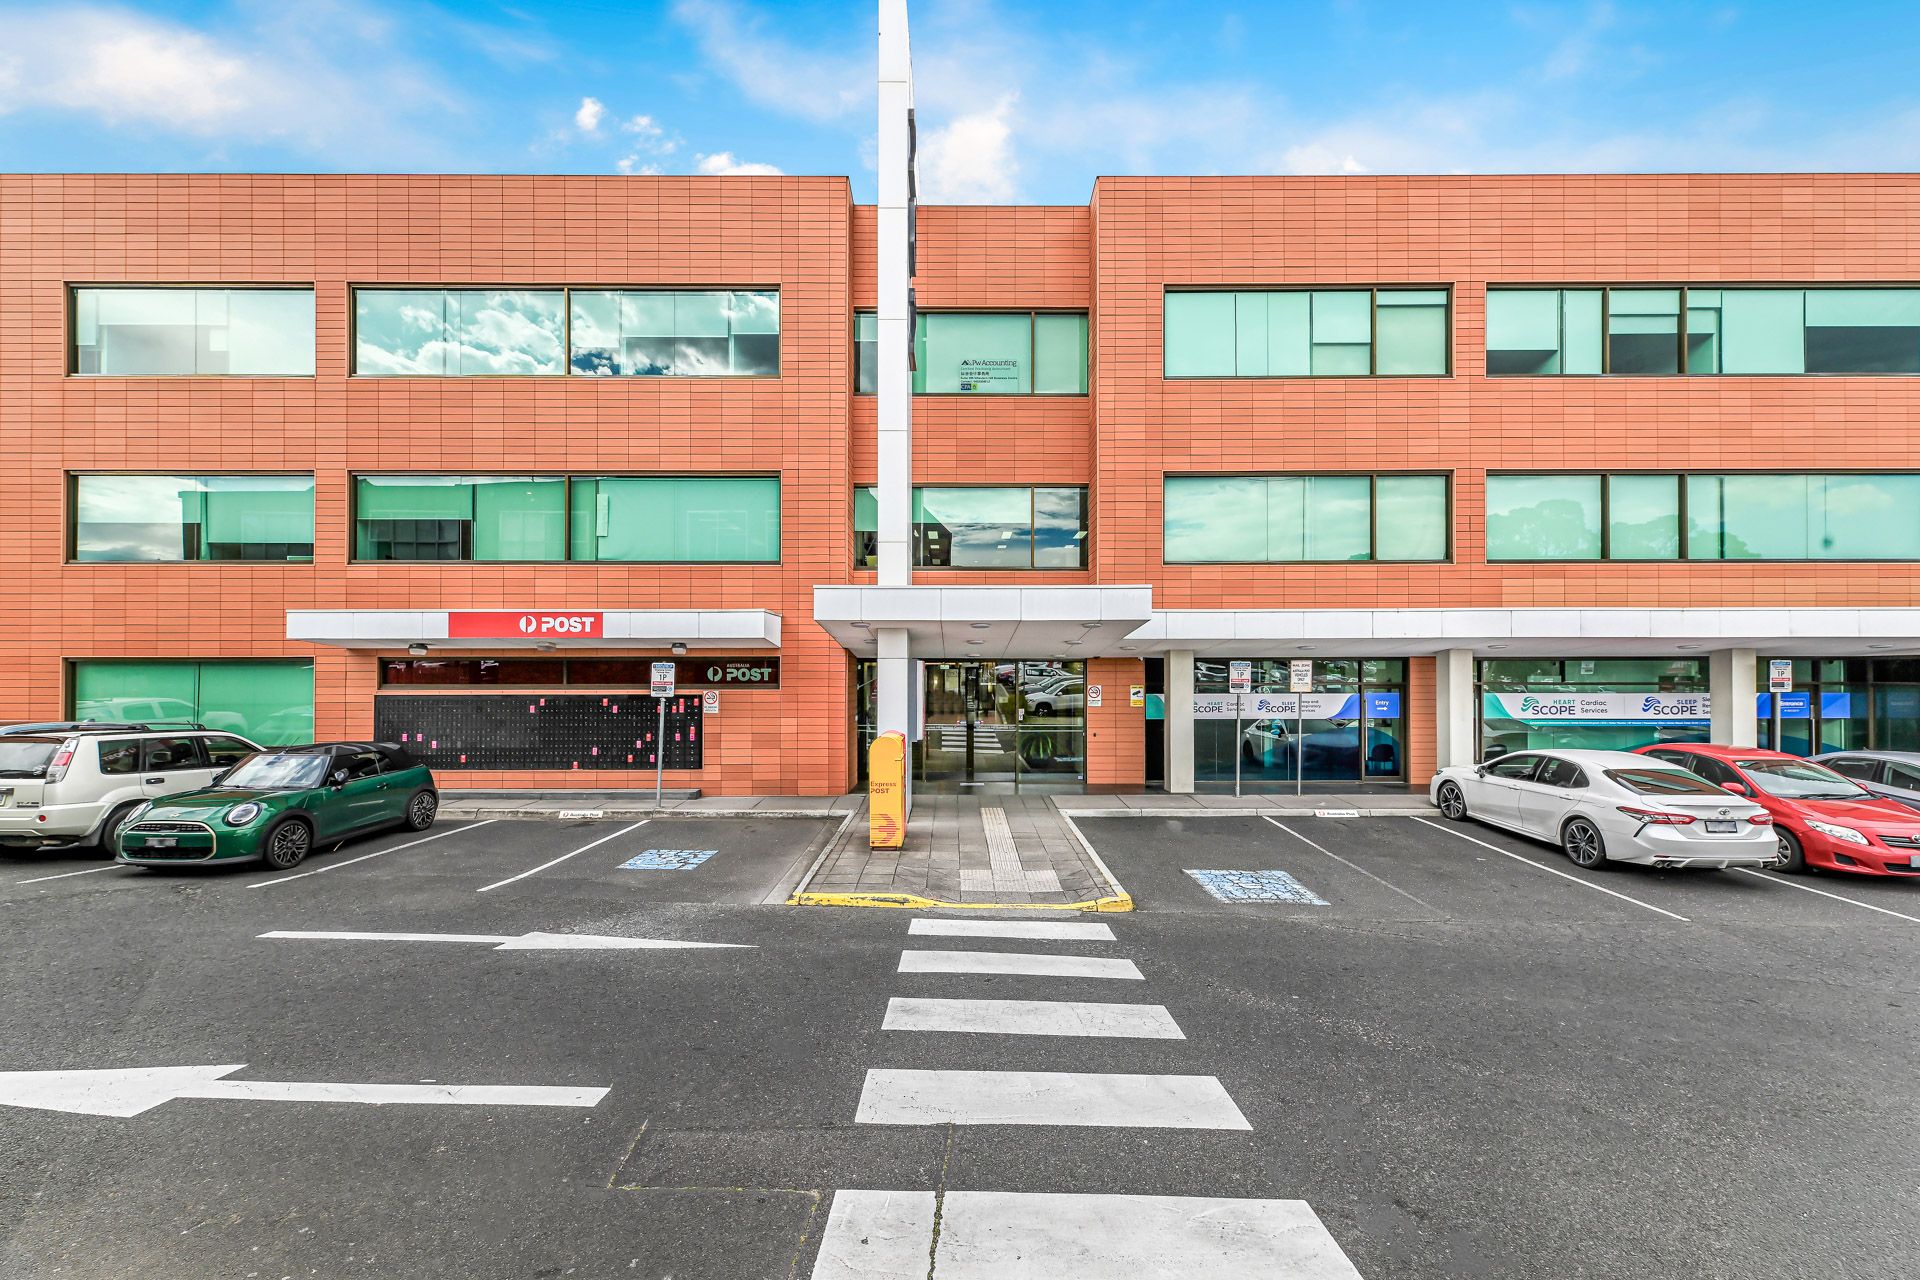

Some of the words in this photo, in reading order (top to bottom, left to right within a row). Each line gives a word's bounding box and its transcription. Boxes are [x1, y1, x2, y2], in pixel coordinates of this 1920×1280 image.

[542, 616, 594, 633] POST
[726, 668, 771, 681] POST
[1265, 705, 1296, 713] SCOPE
[1532, 705, 1575, 715] SCOPE
[1653, 705, 1698, 715] SCOPE
